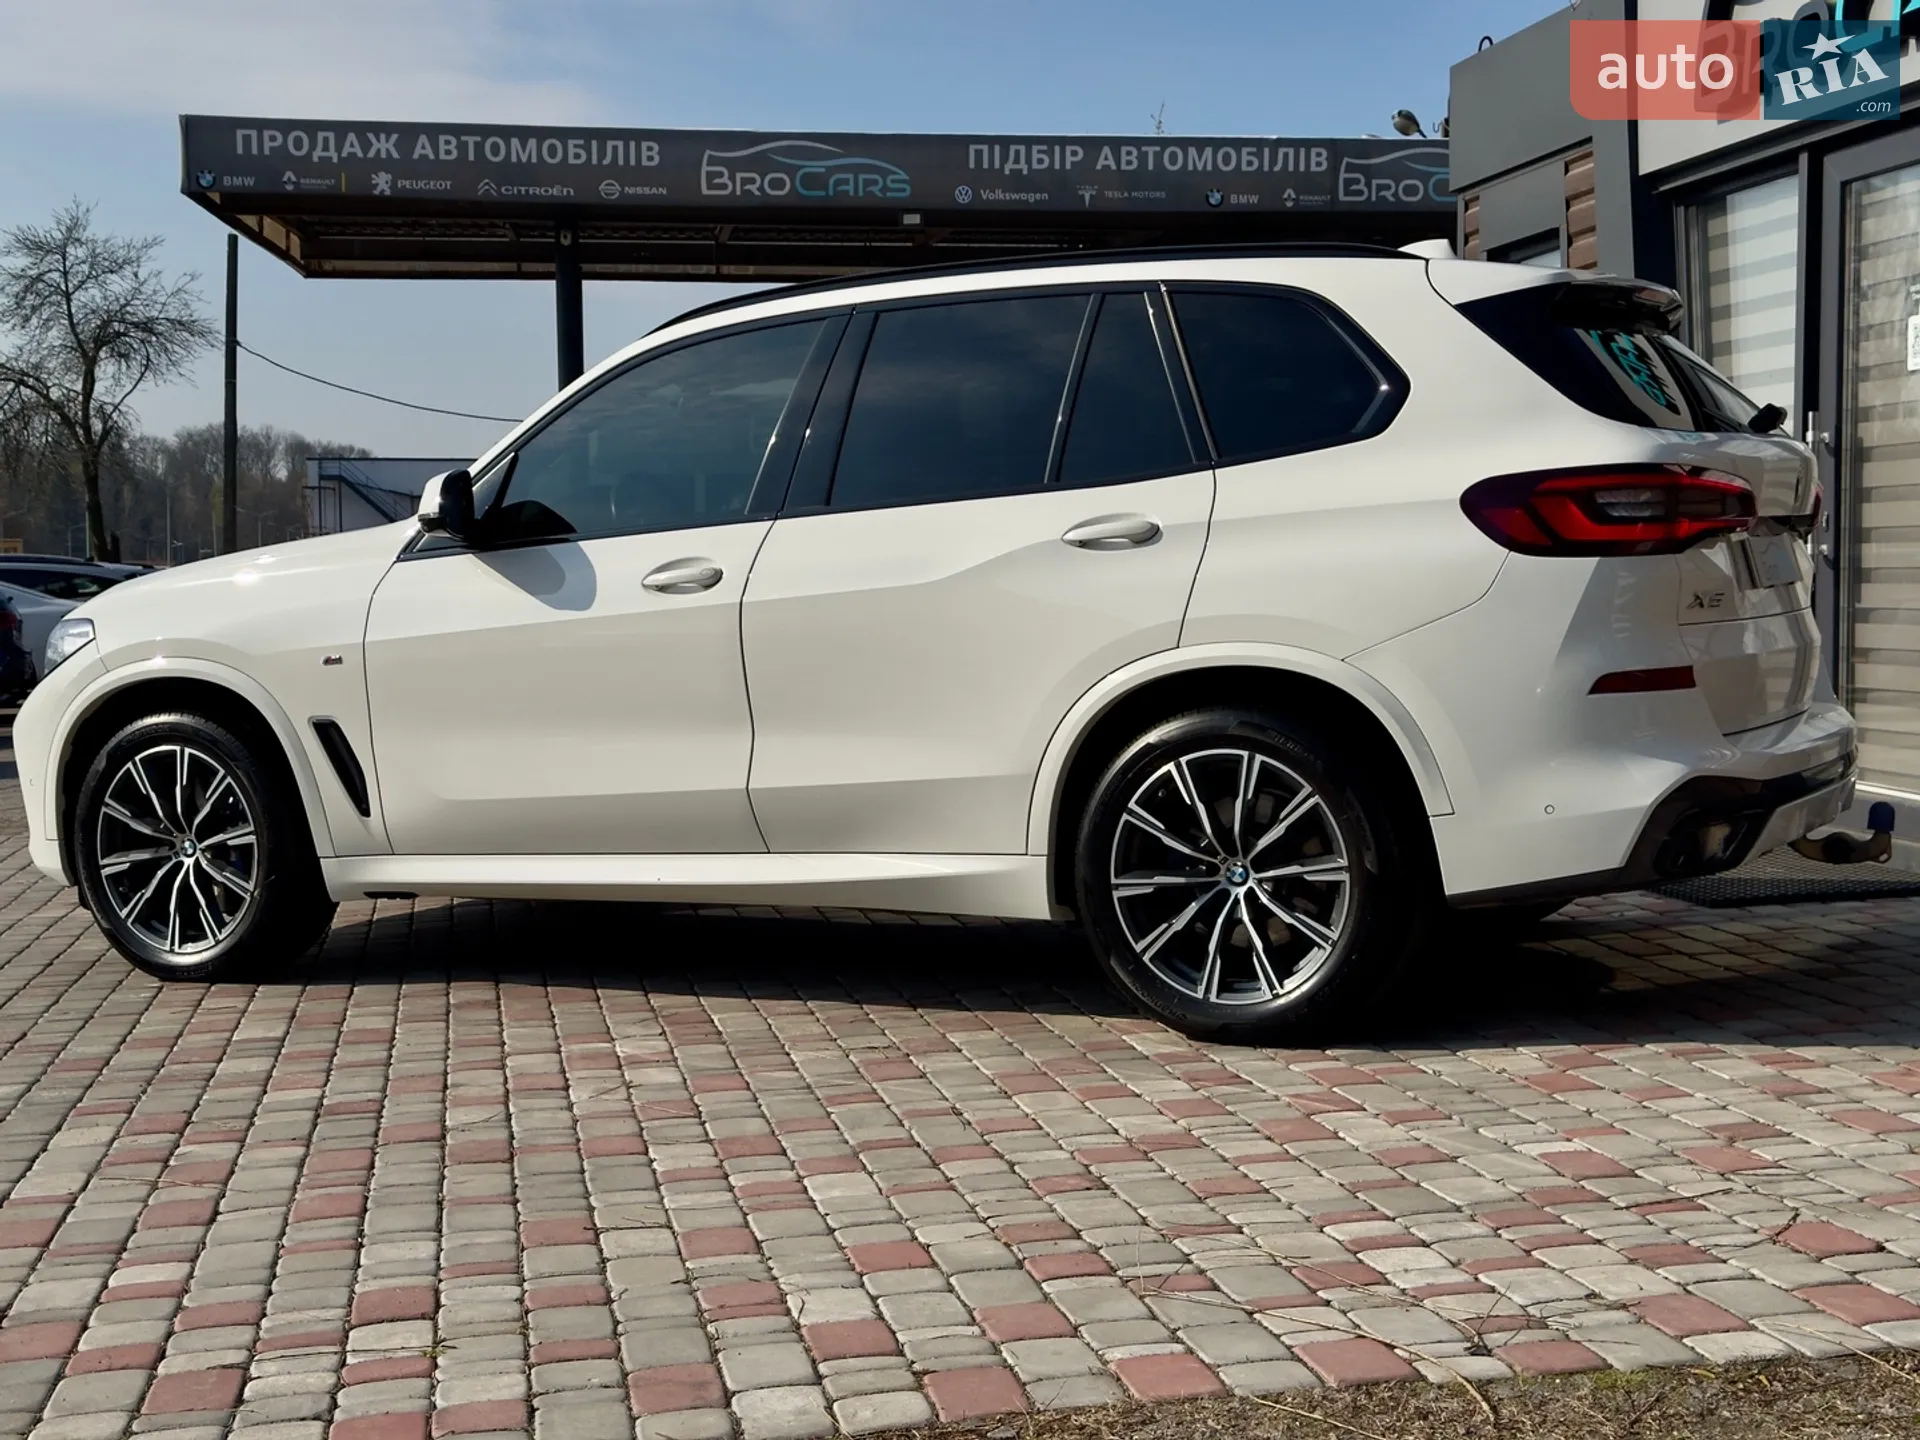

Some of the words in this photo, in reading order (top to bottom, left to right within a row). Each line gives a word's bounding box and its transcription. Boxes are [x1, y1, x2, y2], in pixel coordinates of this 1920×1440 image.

[235, 128, 400, 163] ПРОДАЖ
[412, 133, 660, 167] АВТОМОБІЛІВ
[968, 144, 1084, 175] ПІДБІР
[1095, 145, 1329, 172] АВТОМОБІЛІВ
[222, 175, 256, 187] BMW
[397, 178, 452, 190] PEUGEOT
[624, 186, 668, 195] NISSAN
[980, 188, 1049, 203] Volkswagen
[1103, 190, 1129, 199] TESLA
[1131, 190, 1167, 199] MOTORS
[1229, 193, 1260, 205] BMW
